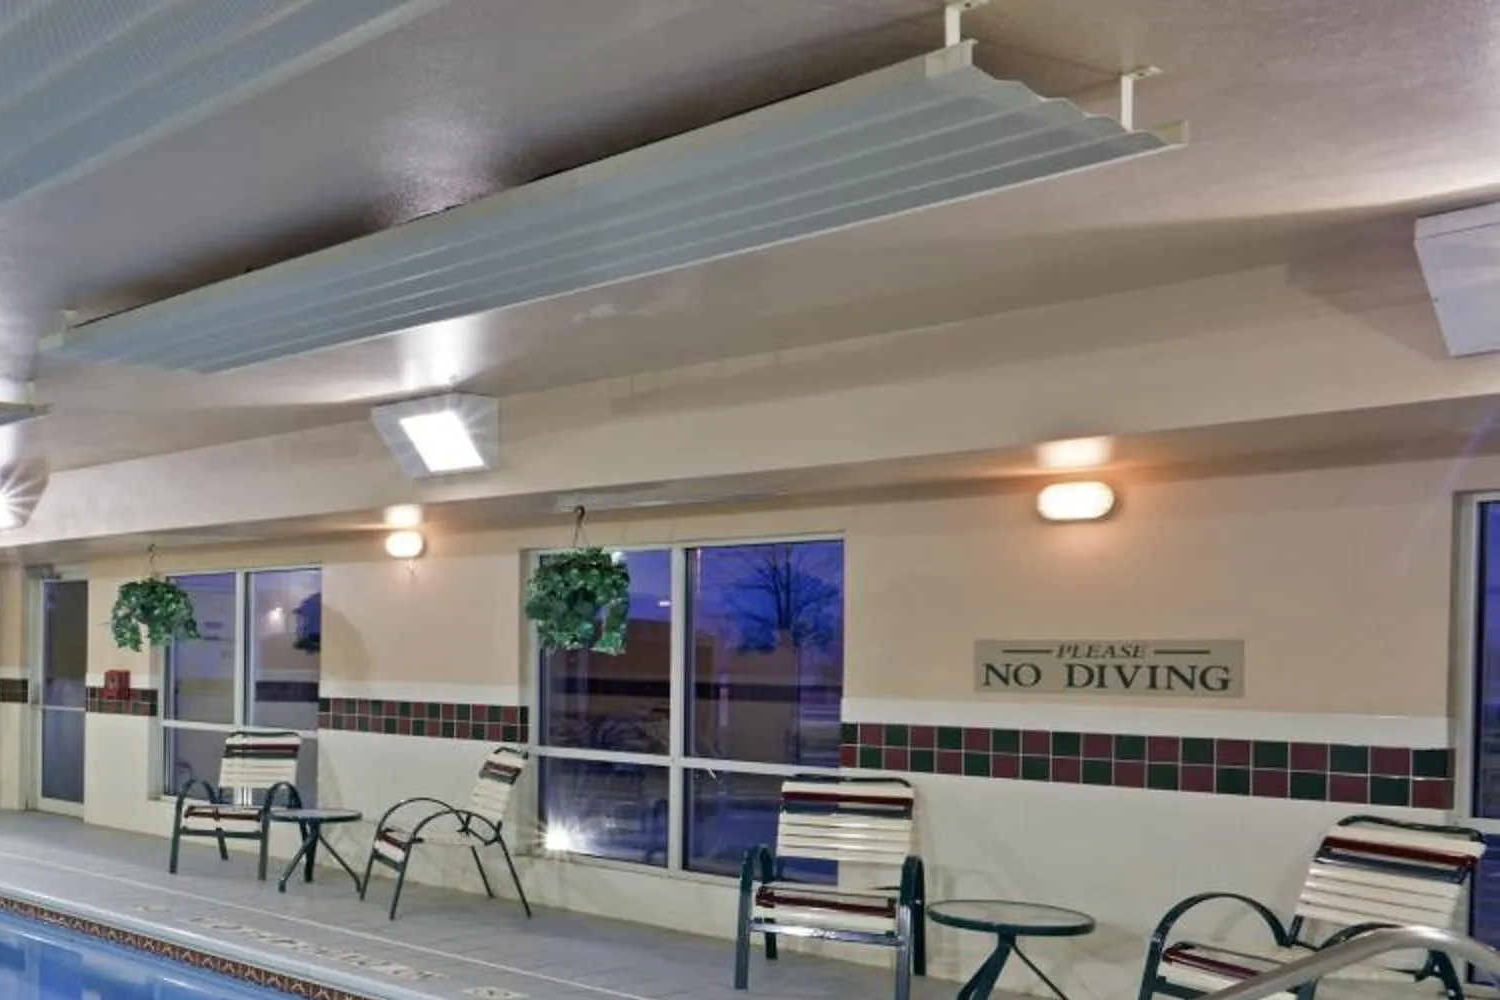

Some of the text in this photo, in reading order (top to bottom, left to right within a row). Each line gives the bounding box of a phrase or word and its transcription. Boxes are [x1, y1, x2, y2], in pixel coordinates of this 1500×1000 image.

[1055, 643, 1146, 659] PLEASE
[982, 662, 1231, 691] NO DIVING
